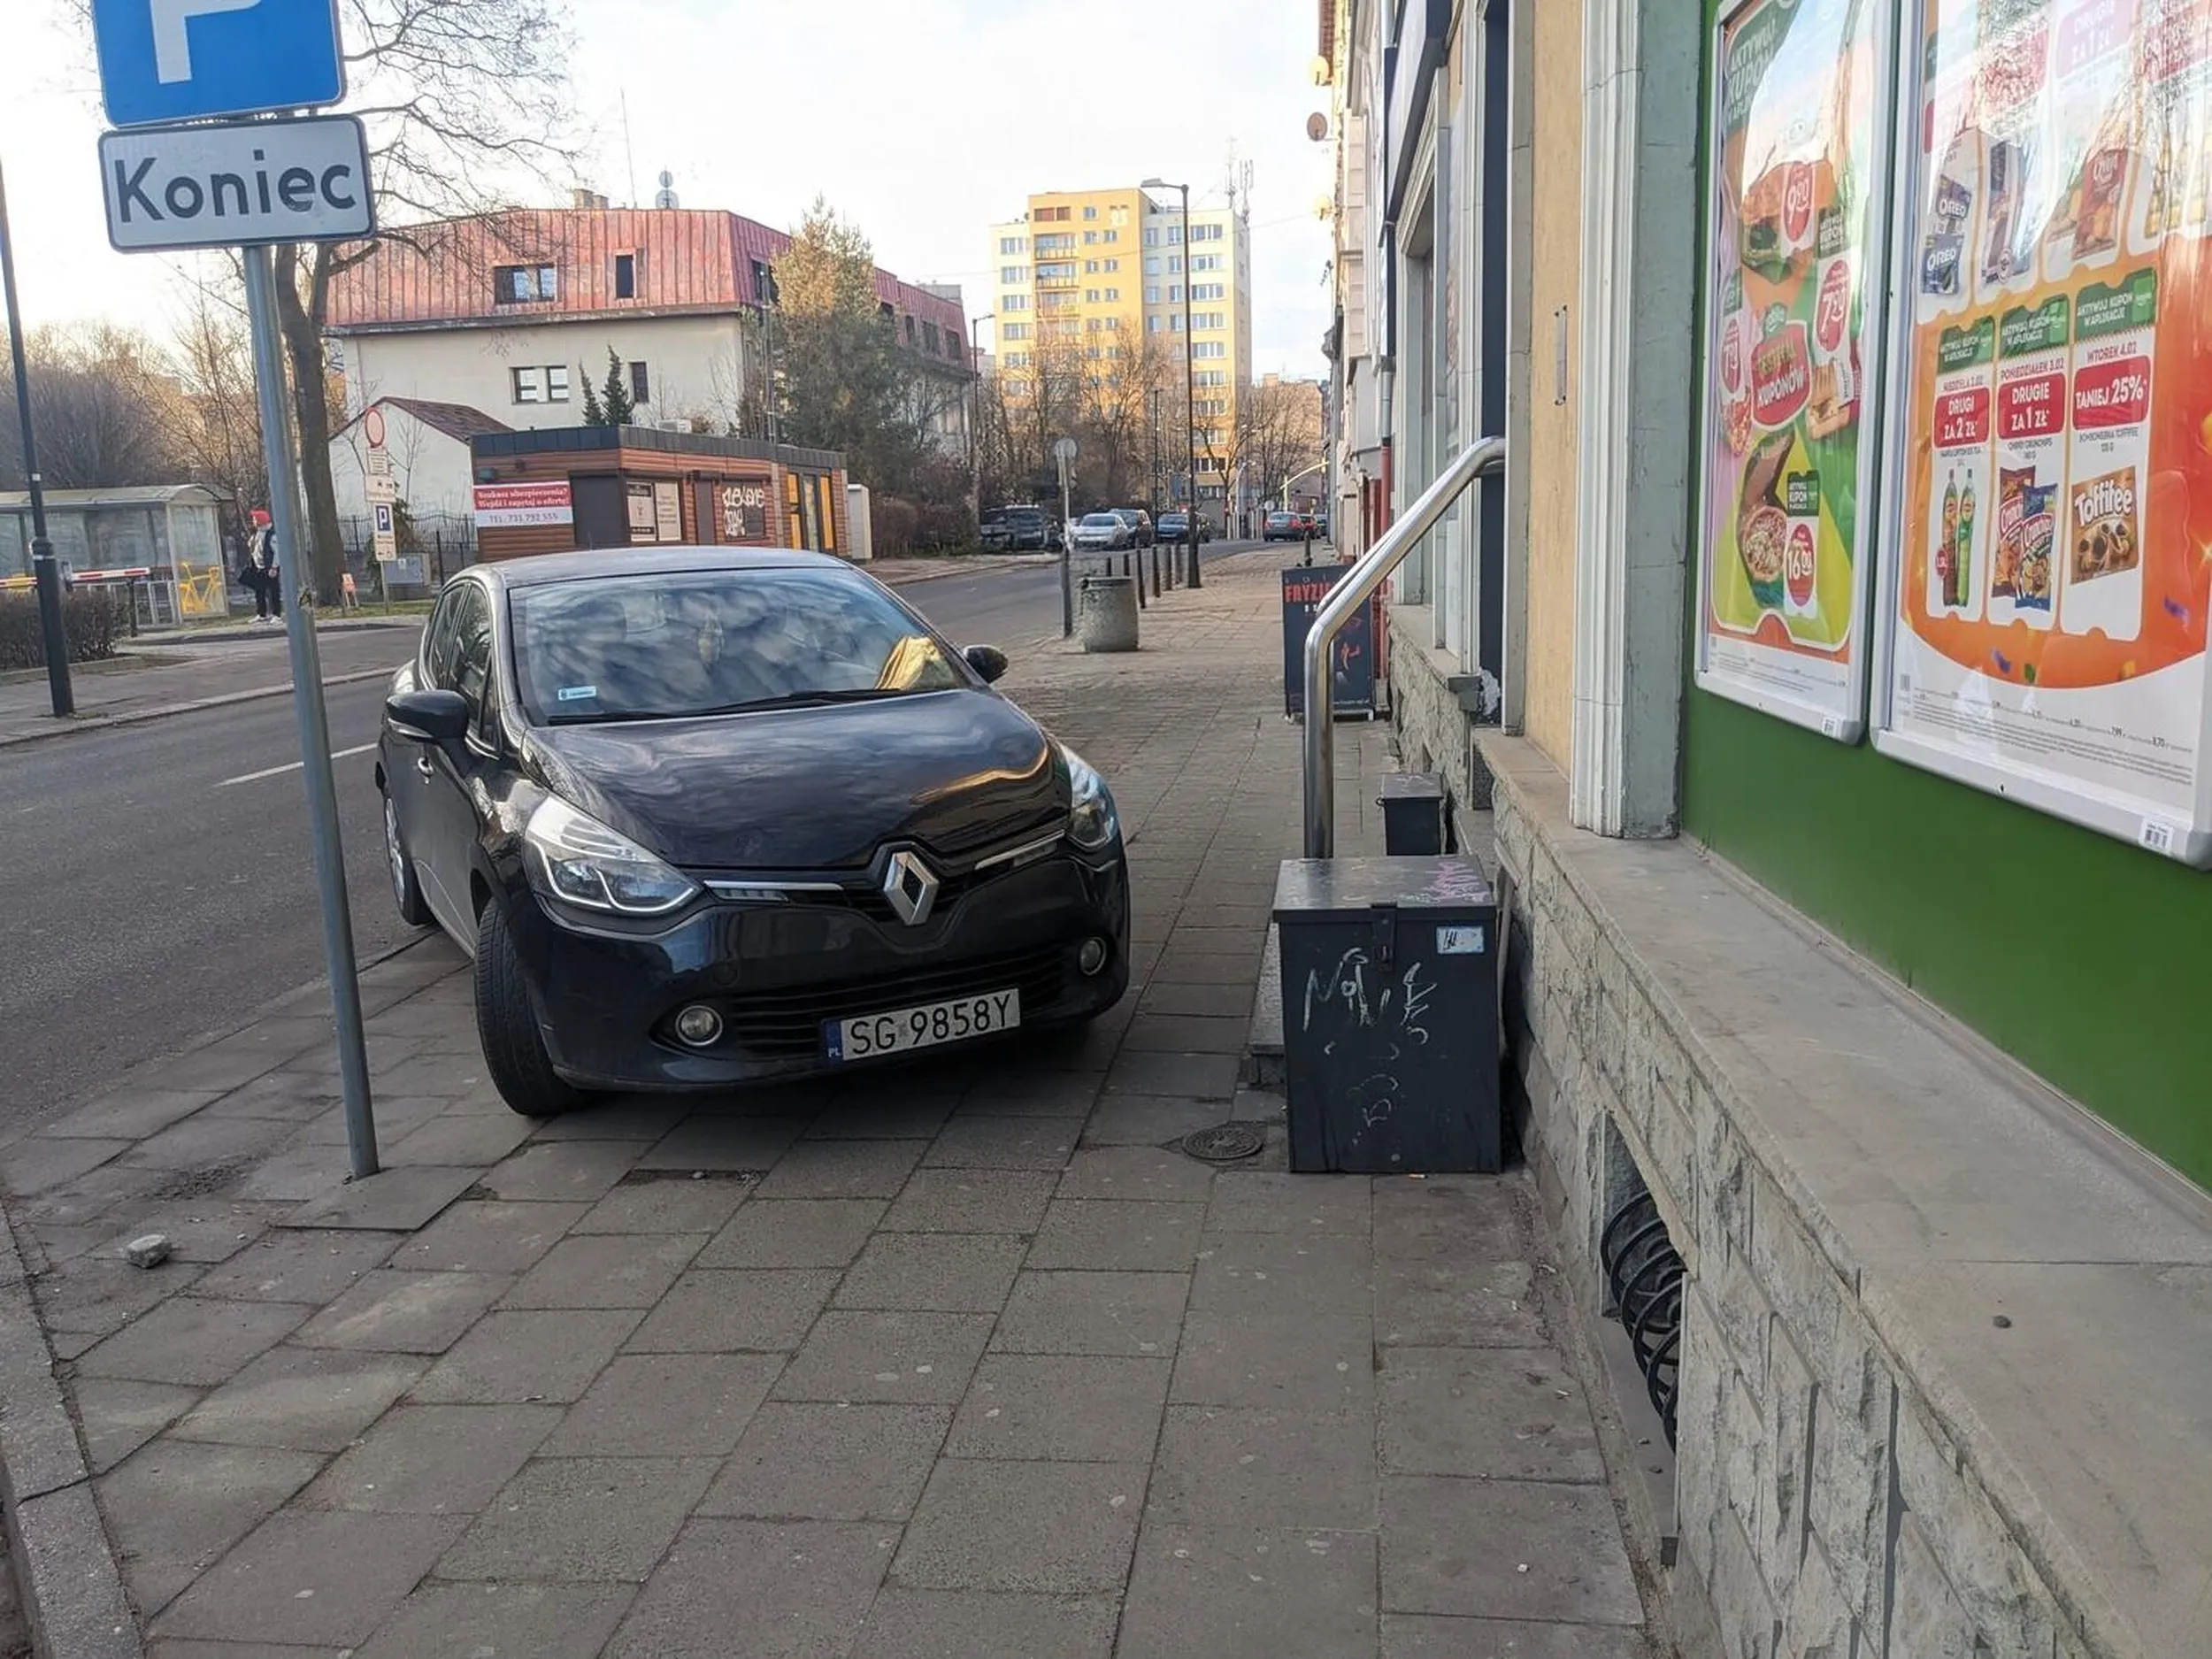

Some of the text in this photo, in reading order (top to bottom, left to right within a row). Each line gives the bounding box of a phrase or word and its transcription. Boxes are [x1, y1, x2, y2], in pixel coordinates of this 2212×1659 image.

[114, 149, 357, 223] Koniec
[1939, 198, 1967, 218] OREO
[1927, 248, 1957, 271] OREO
[2086, 341, 2137, 362] WTOREK 4.02
[2012, 382, 2050, 405] DRUGIE
[2075, 387, 2109, 410] TANIEJ
[1948, 396, 1975, 416] DRUGI
[1944, 424, 1955, 440] ZA
[1956, 418, 1963, 439] 2
[2012, 413, 2025, 431] ZA
[2026, 406, 2032, 429] 1
[2074, 480, 2133, 527] Toffifee
[378, 508, 388, 529] P
[850, 994, 1010, 1055] SG 9858Y
[828, 1048, 841, 1057] PL
